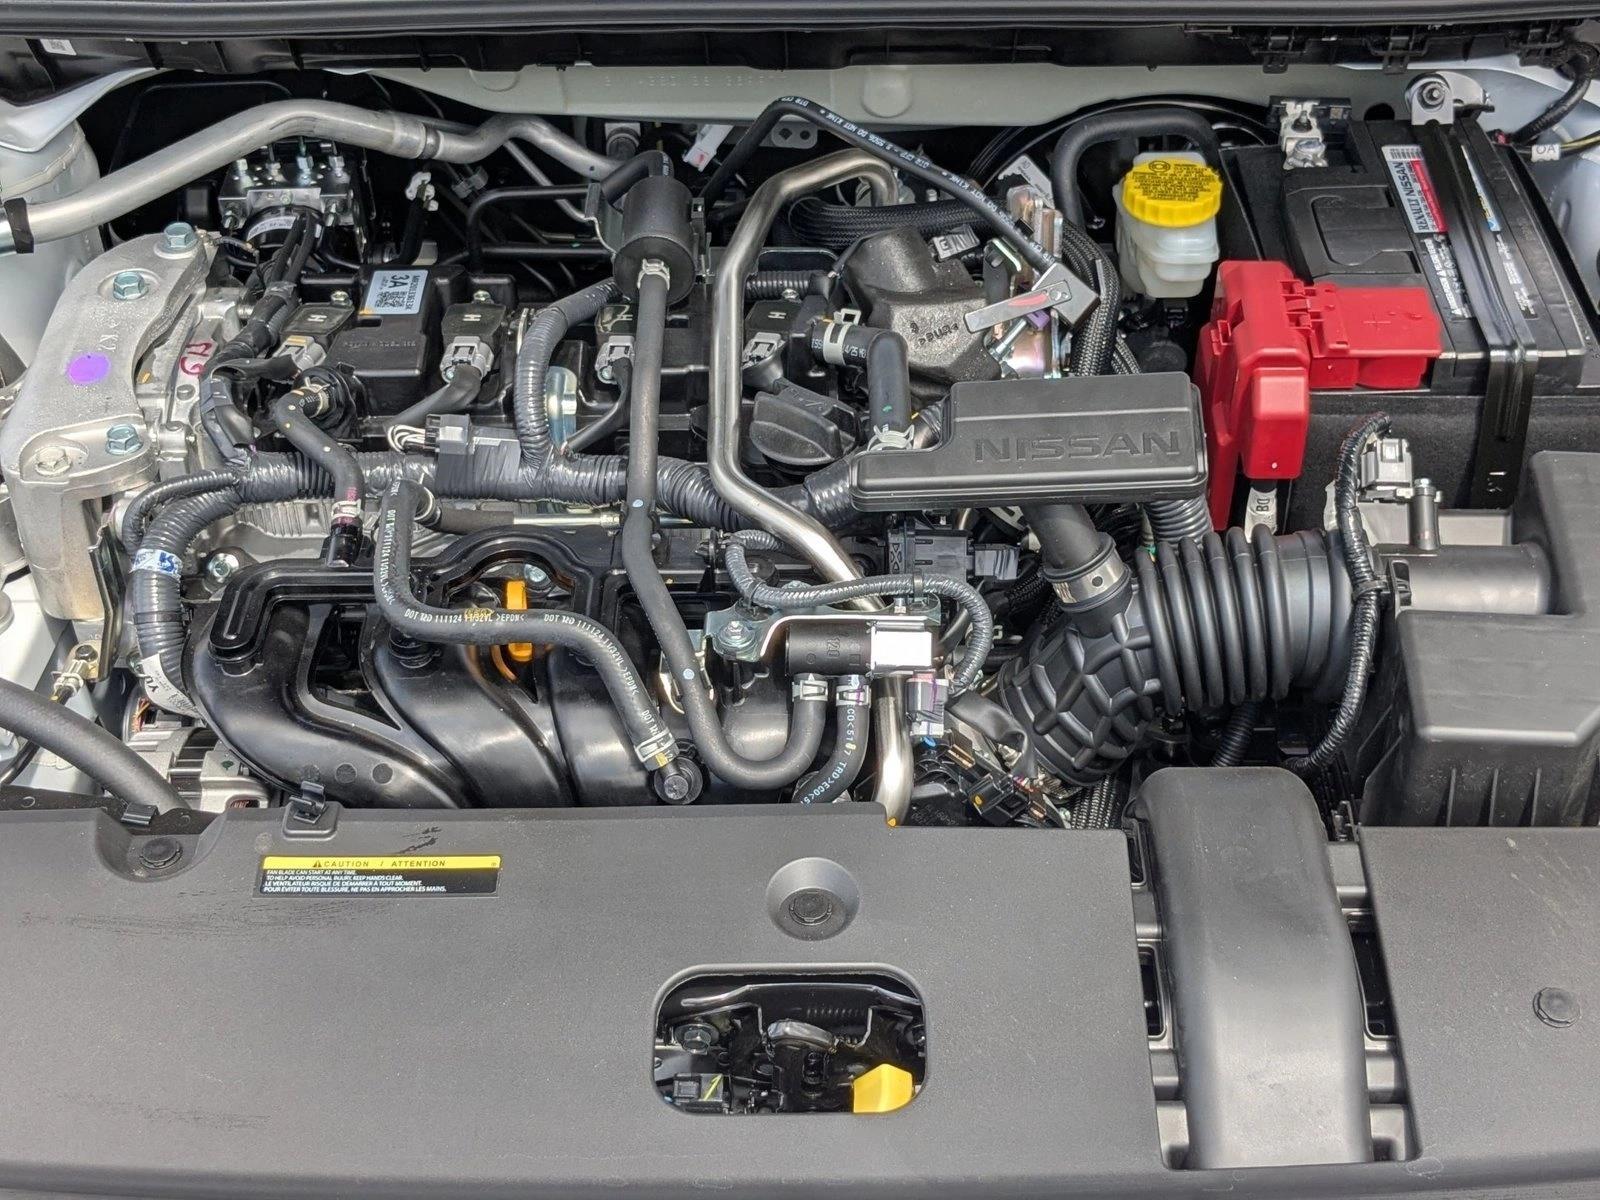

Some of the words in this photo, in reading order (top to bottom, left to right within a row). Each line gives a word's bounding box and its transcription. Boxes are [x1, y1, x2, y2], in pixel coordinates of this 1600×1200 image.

[825, 111, 842, 126] KINK
[843, 121, 858, 132] NOT
[857, 128, 869, 138] DO
[949, 175, 970, 189] KINK
[1393, 161, 1416, 197] NISSAN
[971, 189, 986, 203] NOT
[986, 200, 998, 212] DO
[1407, 198, 1430, 231] RENAULT
[389, 274, 410, 288] 3A
[975, 431, 1180, 463] NISSAN
[404, 608, 420, 620] DOT
[435, 614, 462, 624] 111124
[543, 613, 559, 624] DOT
[576, 619, 605, 639] 111124
[641, 709, 656, 725] DOT
